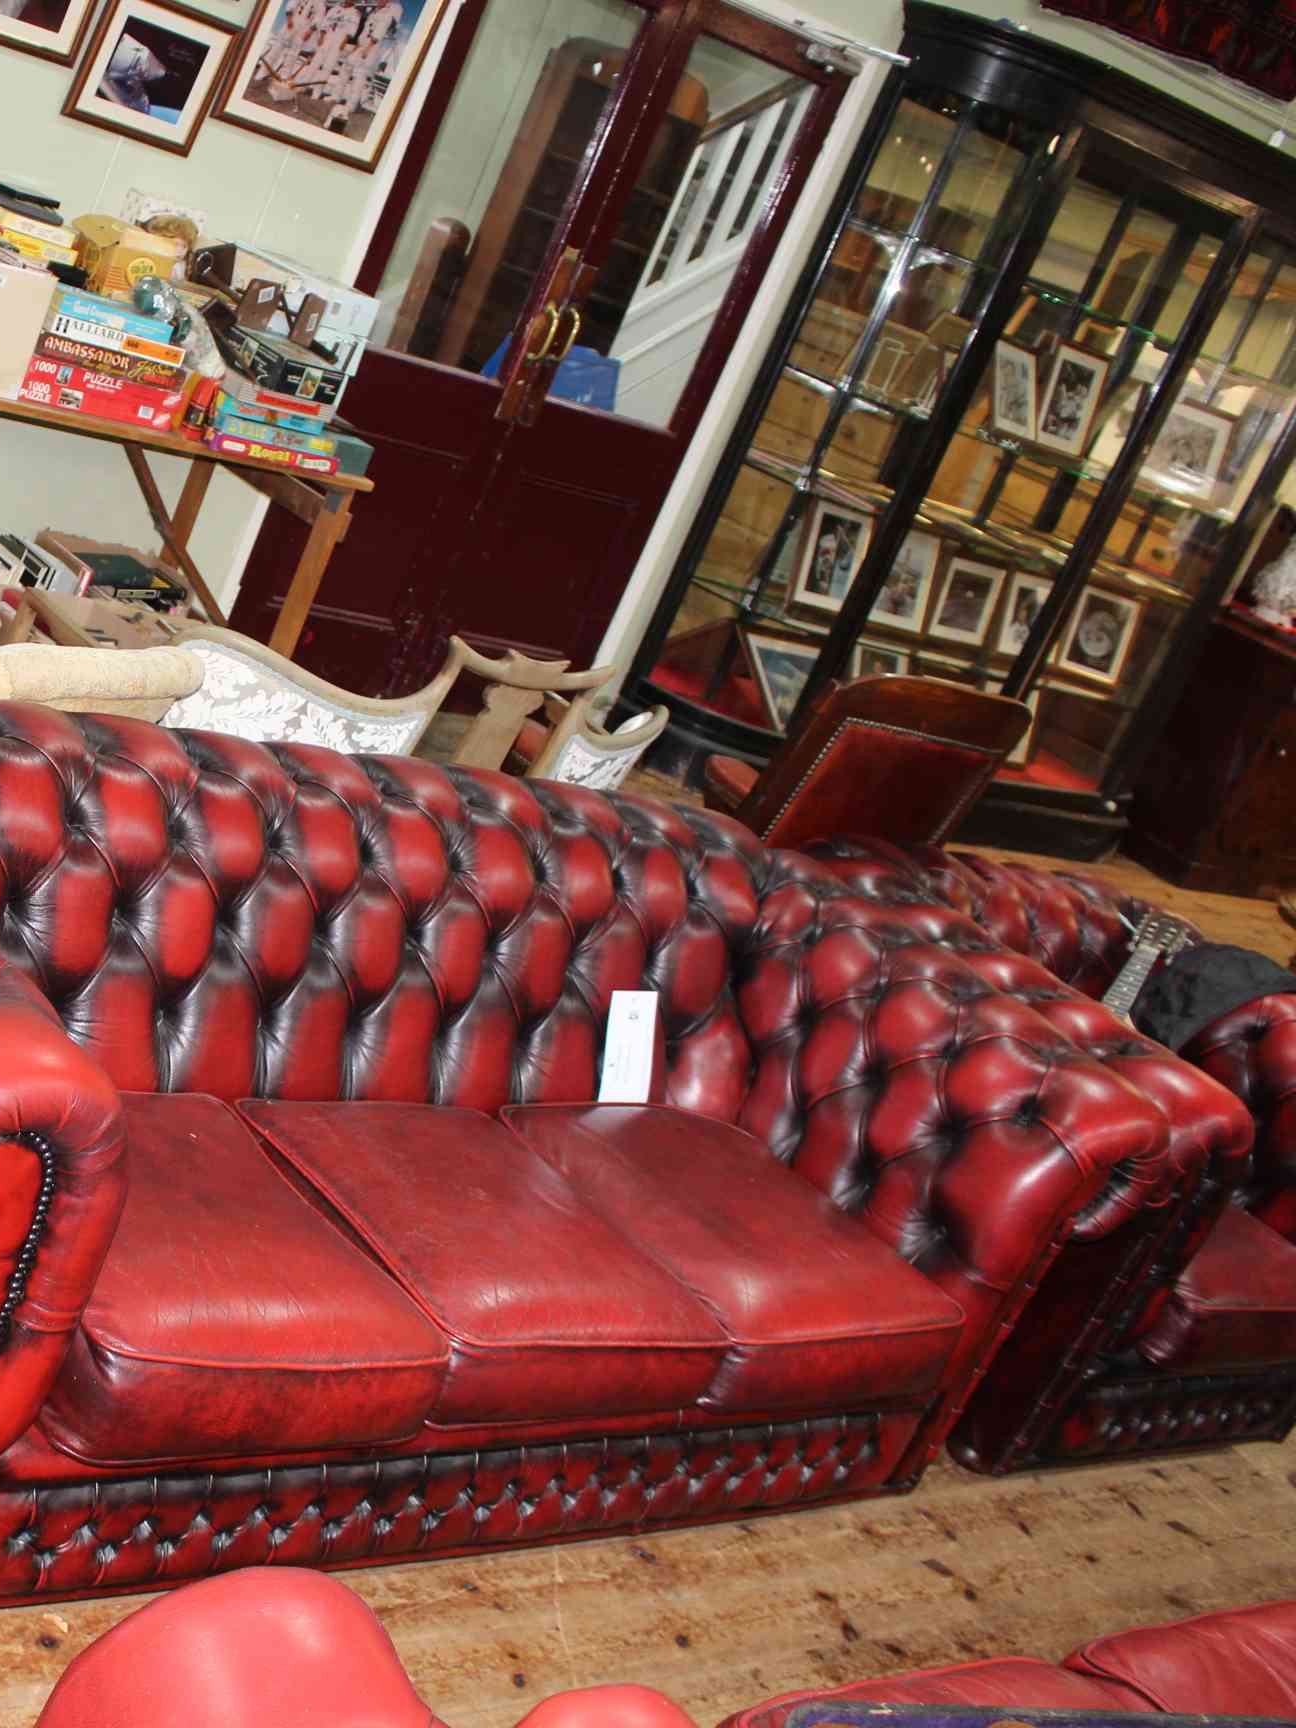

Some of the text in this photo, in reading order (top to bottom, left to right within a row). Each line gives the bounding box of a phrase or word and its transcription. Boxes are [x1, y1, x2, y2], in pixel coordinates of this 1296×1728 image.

[44, 336, 130, 369] AMBASSADOR
[34, 360, 57, 374] 1000
[27, 380, 51, 394] 1000
[83, 371, 124, 390] PUZZLE
[19, 388, 53, 404] PUZZLE
